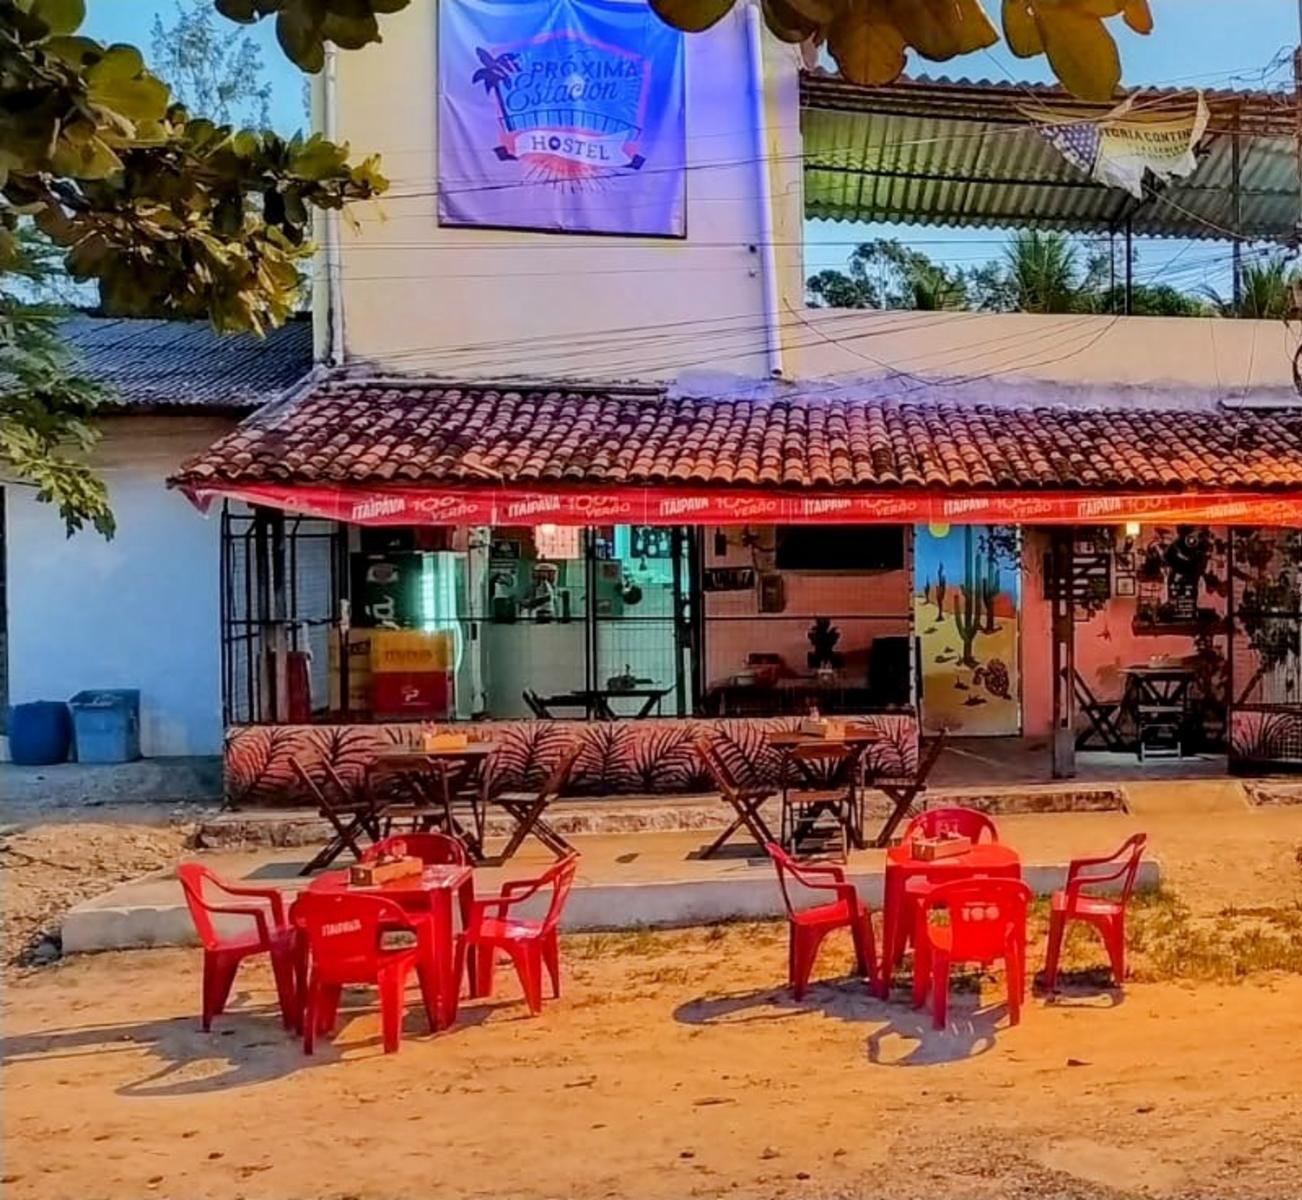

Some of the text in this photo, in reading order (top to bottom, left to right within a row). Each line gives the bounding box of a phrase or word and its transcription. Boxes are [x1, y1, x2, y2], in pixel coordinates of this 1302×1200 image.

[531, 55, 638, 79] PRÓXIMA
[531, 135, 610, 161] HOSTEL
[508, 494, 560, 518] ITAIPAVA
